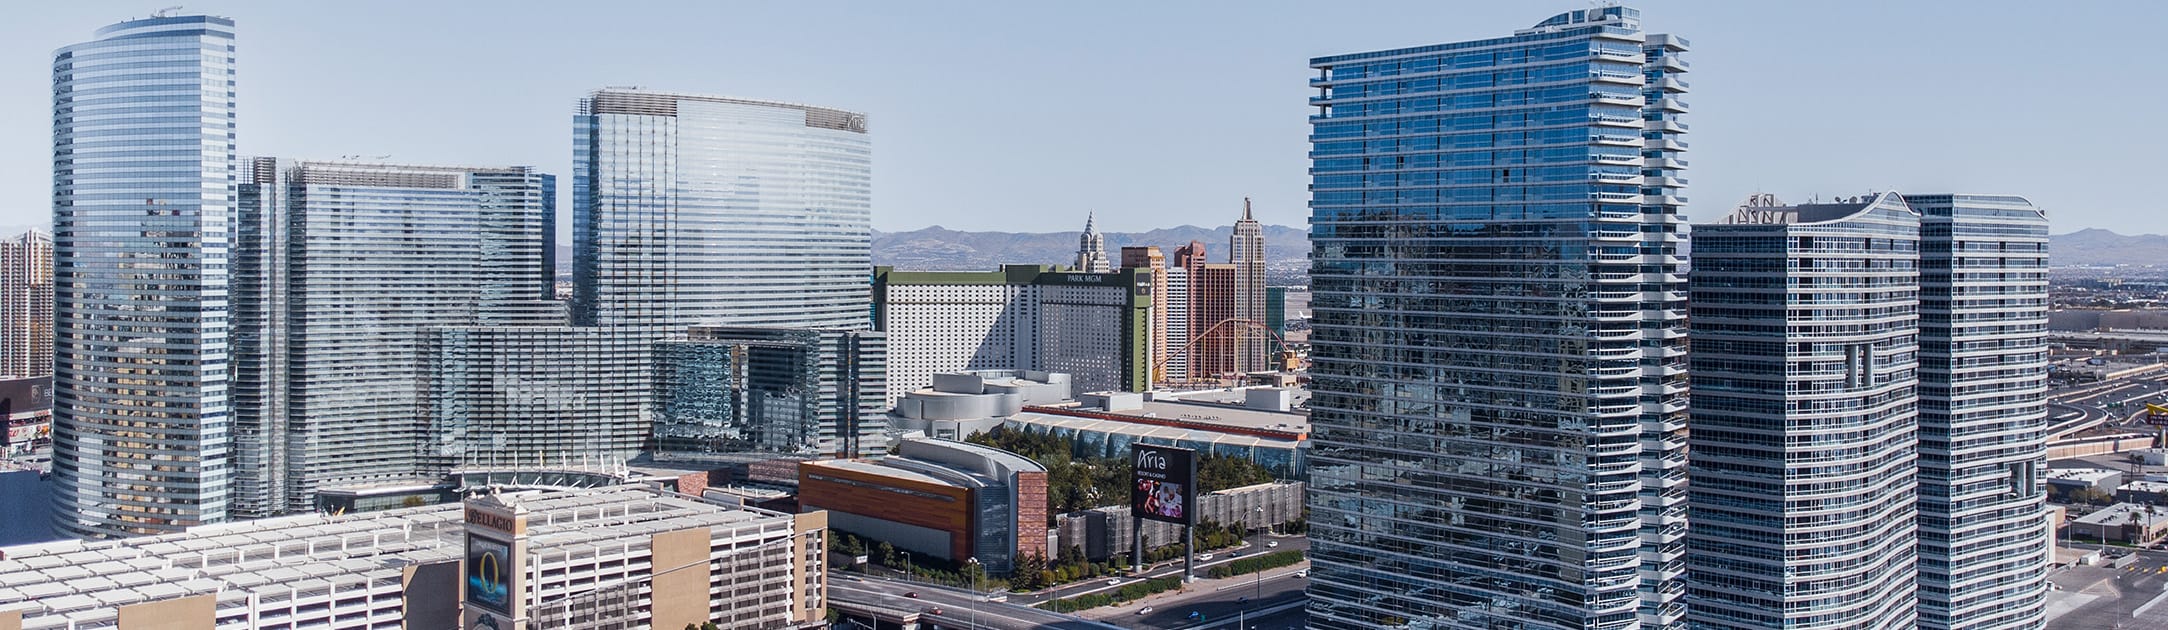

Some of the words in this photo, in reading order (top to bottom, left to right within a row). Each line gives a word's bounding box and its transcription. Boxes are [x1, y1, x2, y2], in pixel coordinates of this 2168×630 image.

[1085, 275, 1102, 283] MGM
[1137, 449, 1166, 469] Aria
[466, 510, 512, 531] BELLAGIO
